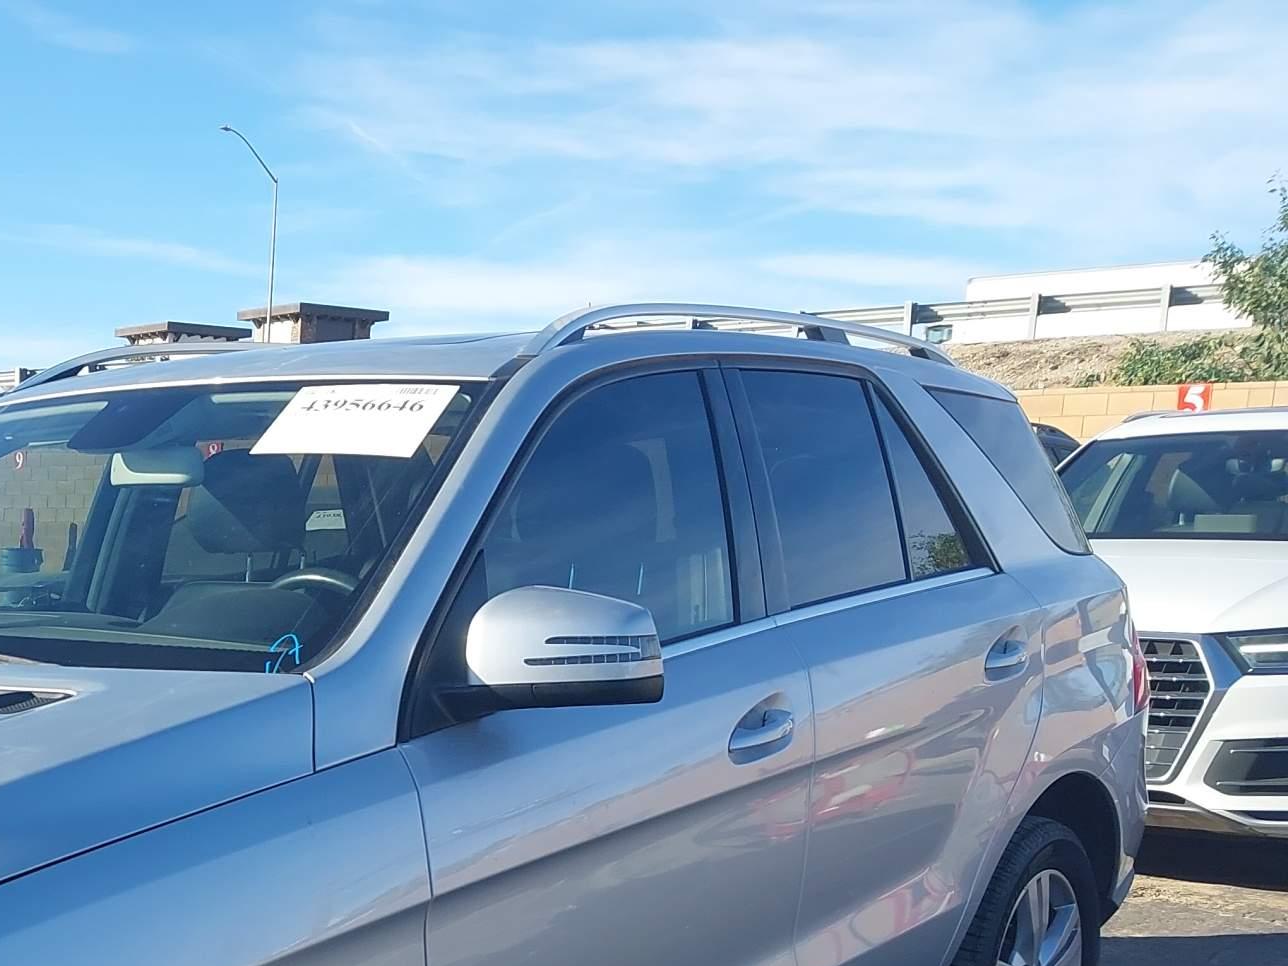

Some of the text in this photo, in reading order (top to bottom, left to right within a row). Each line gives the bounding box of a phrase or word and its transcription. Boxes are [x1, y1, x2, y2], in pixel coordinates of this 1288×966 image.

[300, 398, 425, 413] 43956646
[1182, 384, 1204, 415] 5
[15, 451, 23, 470] 9
